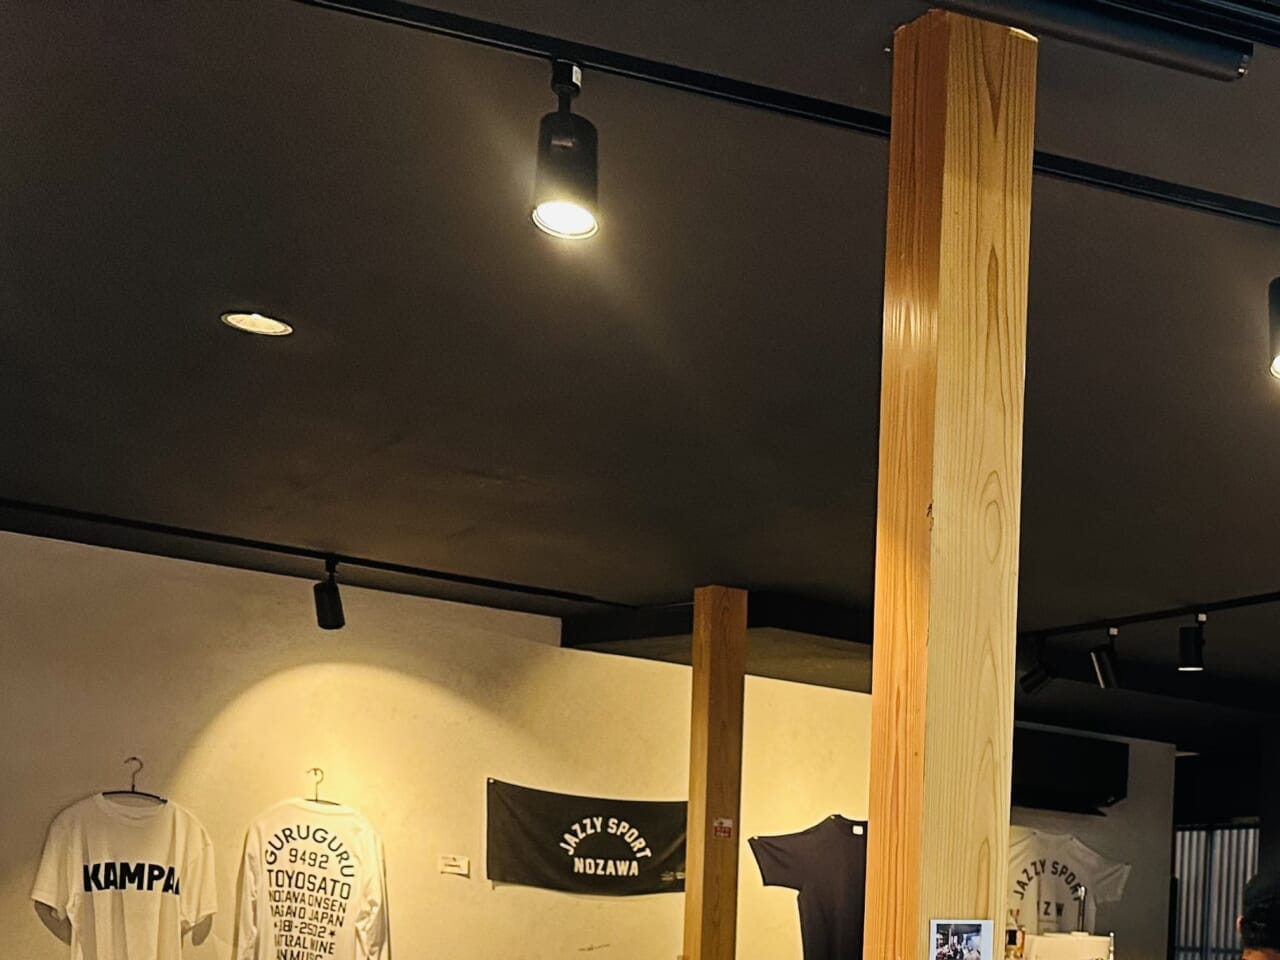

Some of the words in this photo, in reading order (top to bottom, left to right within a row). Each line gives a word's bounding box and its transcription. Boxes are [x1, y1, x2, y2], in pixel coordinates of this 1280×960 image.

[264, 824, 355, 877] GURUGURU
[559, 817, 603, 855] JAZZY
[607, 818, 652, 858] SPORT
[289, 848, 329, 870] 9492
[574, 857, 639, 877] NOZAWA
[267, 869, 351, 900] TOYOSATO
[1013, 859, 1047, 900] JAZZY
